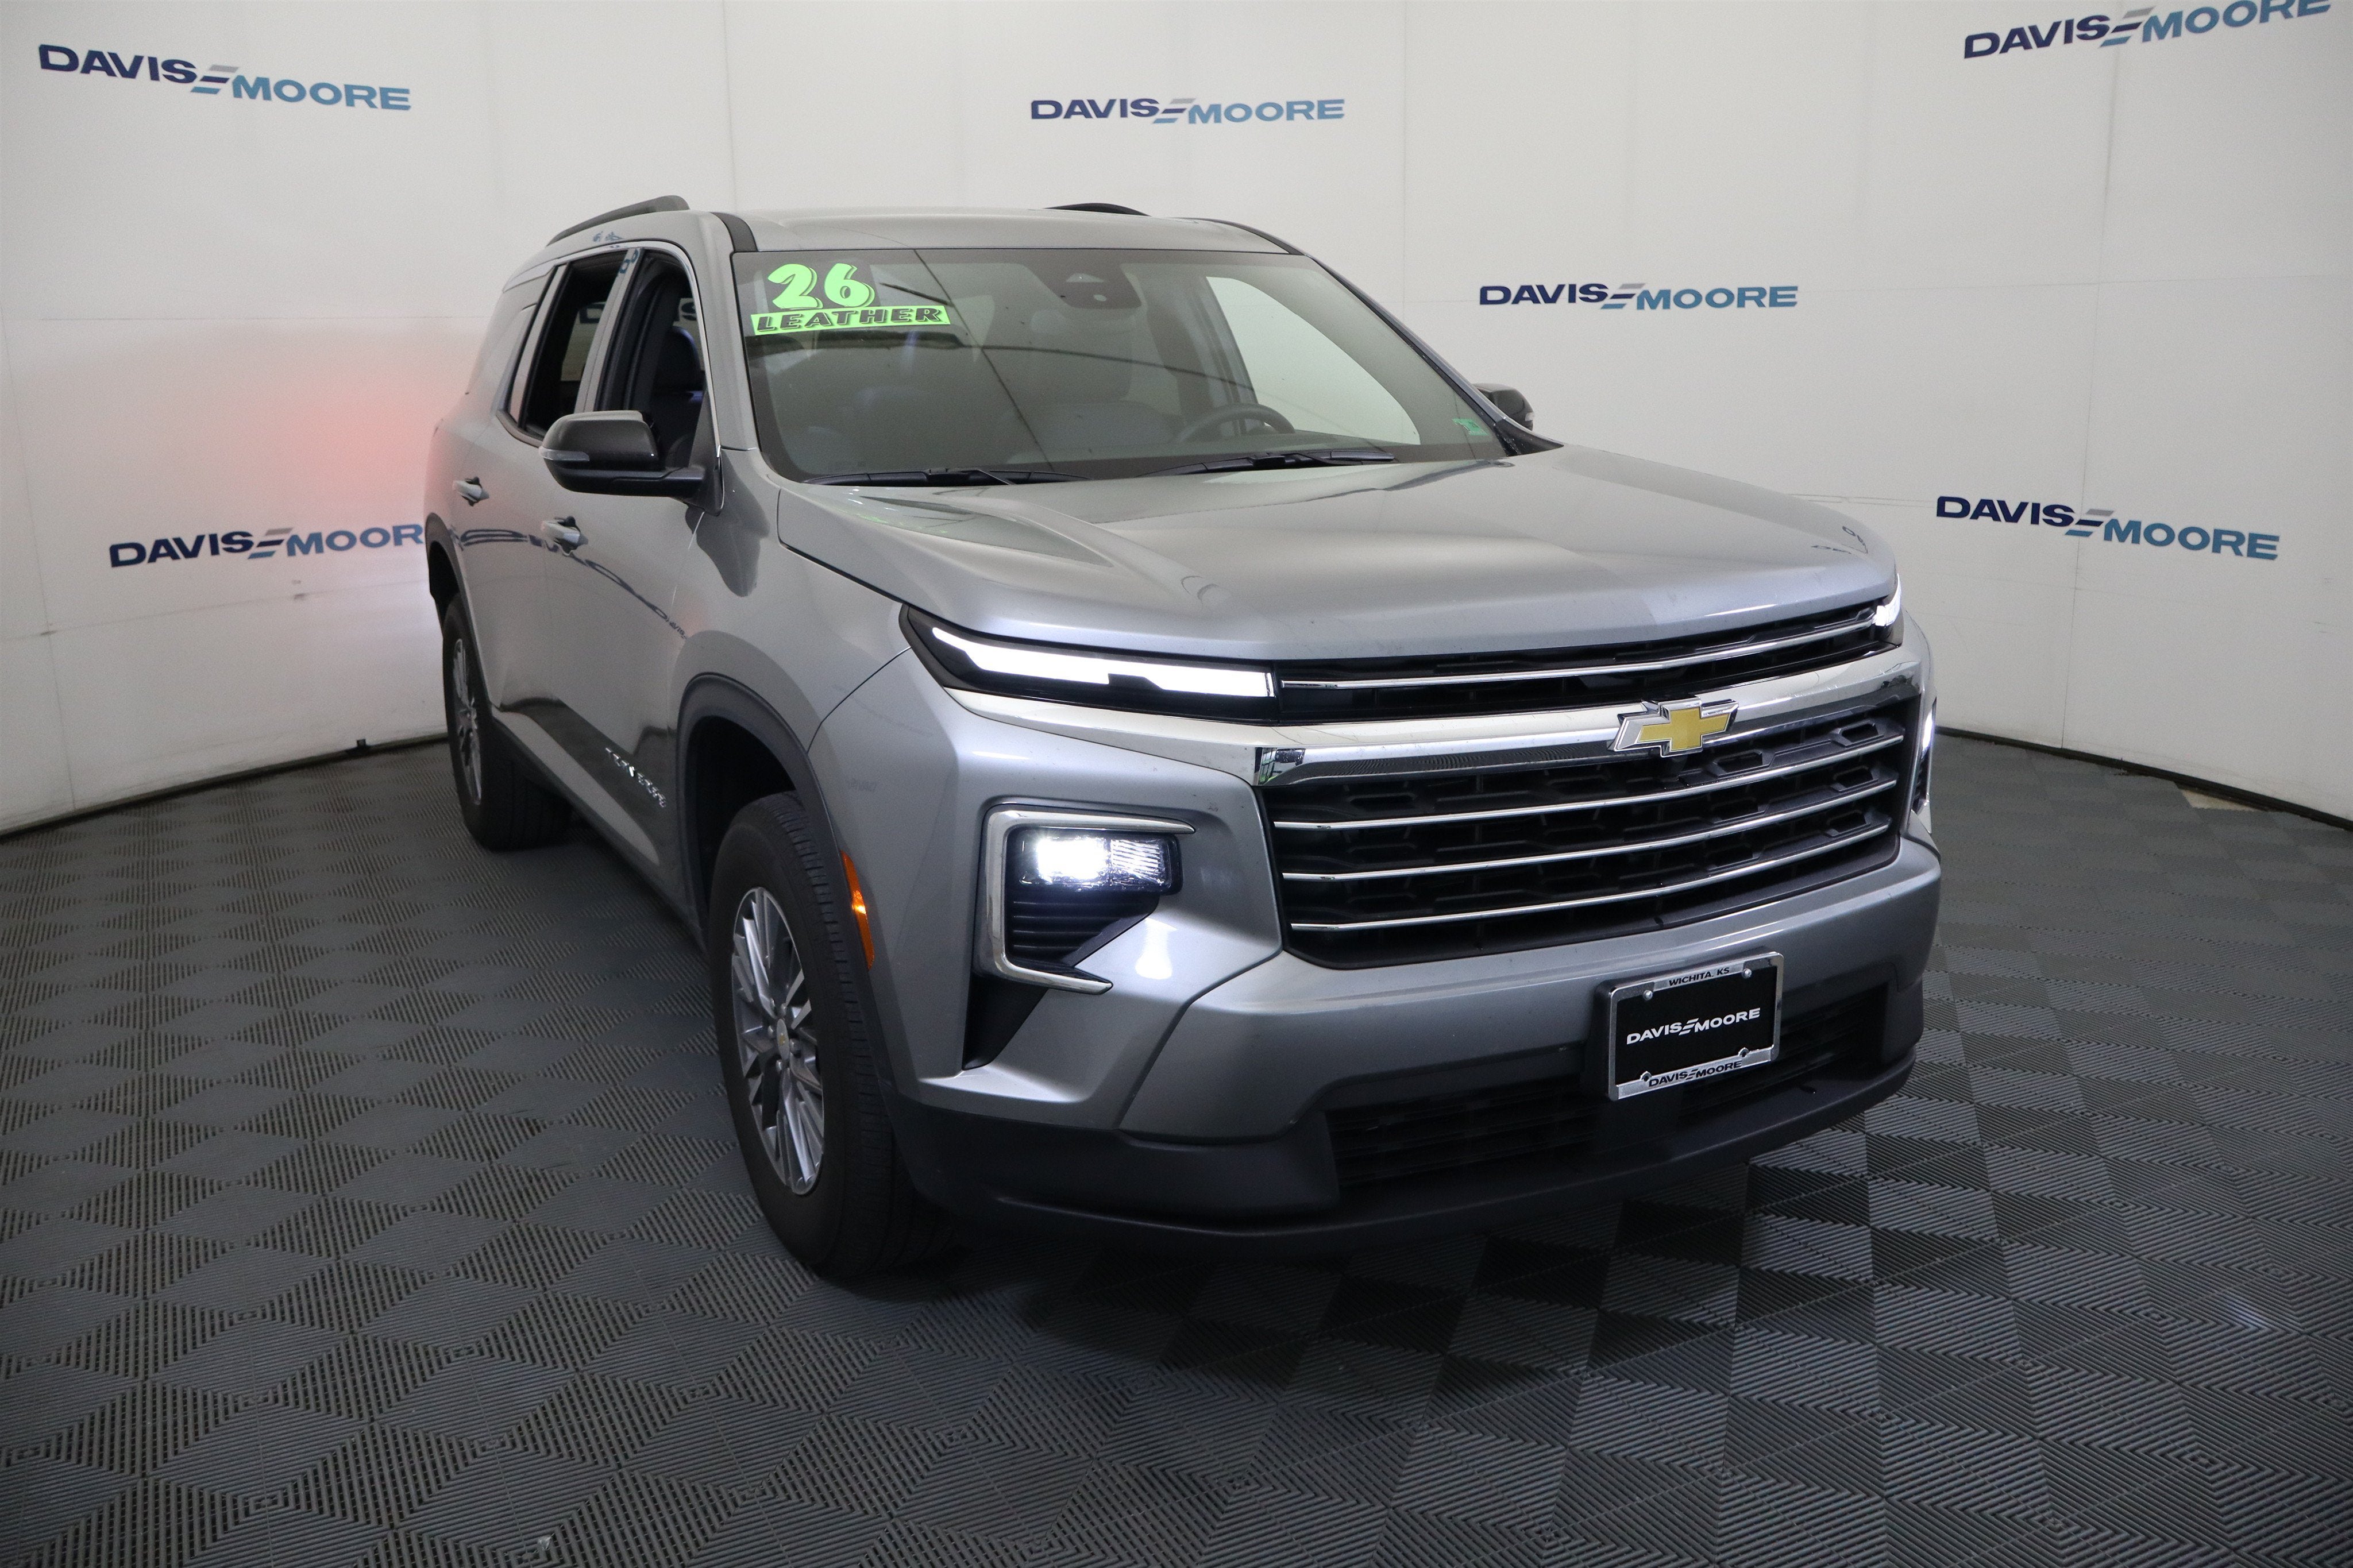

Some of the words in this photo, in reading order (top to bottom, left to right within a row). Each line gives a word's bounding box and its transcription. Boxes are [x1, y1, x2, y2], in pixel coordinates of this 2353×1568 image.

[1964, 14, 2112, 59] DAVIS
[38, 44, 198, 84] DAVIS
[232, 75, 412, 111] MOORE
[1031, 98, 1160, 119] DAVIS
[1187, 99, 1345, 124] MOORE
[767, 263, 875, 309] 26
[1479, 283, 1609, 305] DAVIS
[1636, 286, 1798, 310] MOORE
[757, 308, 942, 331] LEATHER
[110, 531, 254, 567] DAVIS
[286, 524, 424, 557] MOOR
[1937, 496, 2074, 527] DAVIS
[2103, 519, 2280, 560] MOORE
[1716, 967, 1730, 976] KS
[1626, 1022, 1682, 1045] DAVIS
[1695, 1007, 1761, 1033] MOORE
[1649, 1072, 1688, 1087] DAVIS
[1696, 1061, 1742, 1077] MOORE
